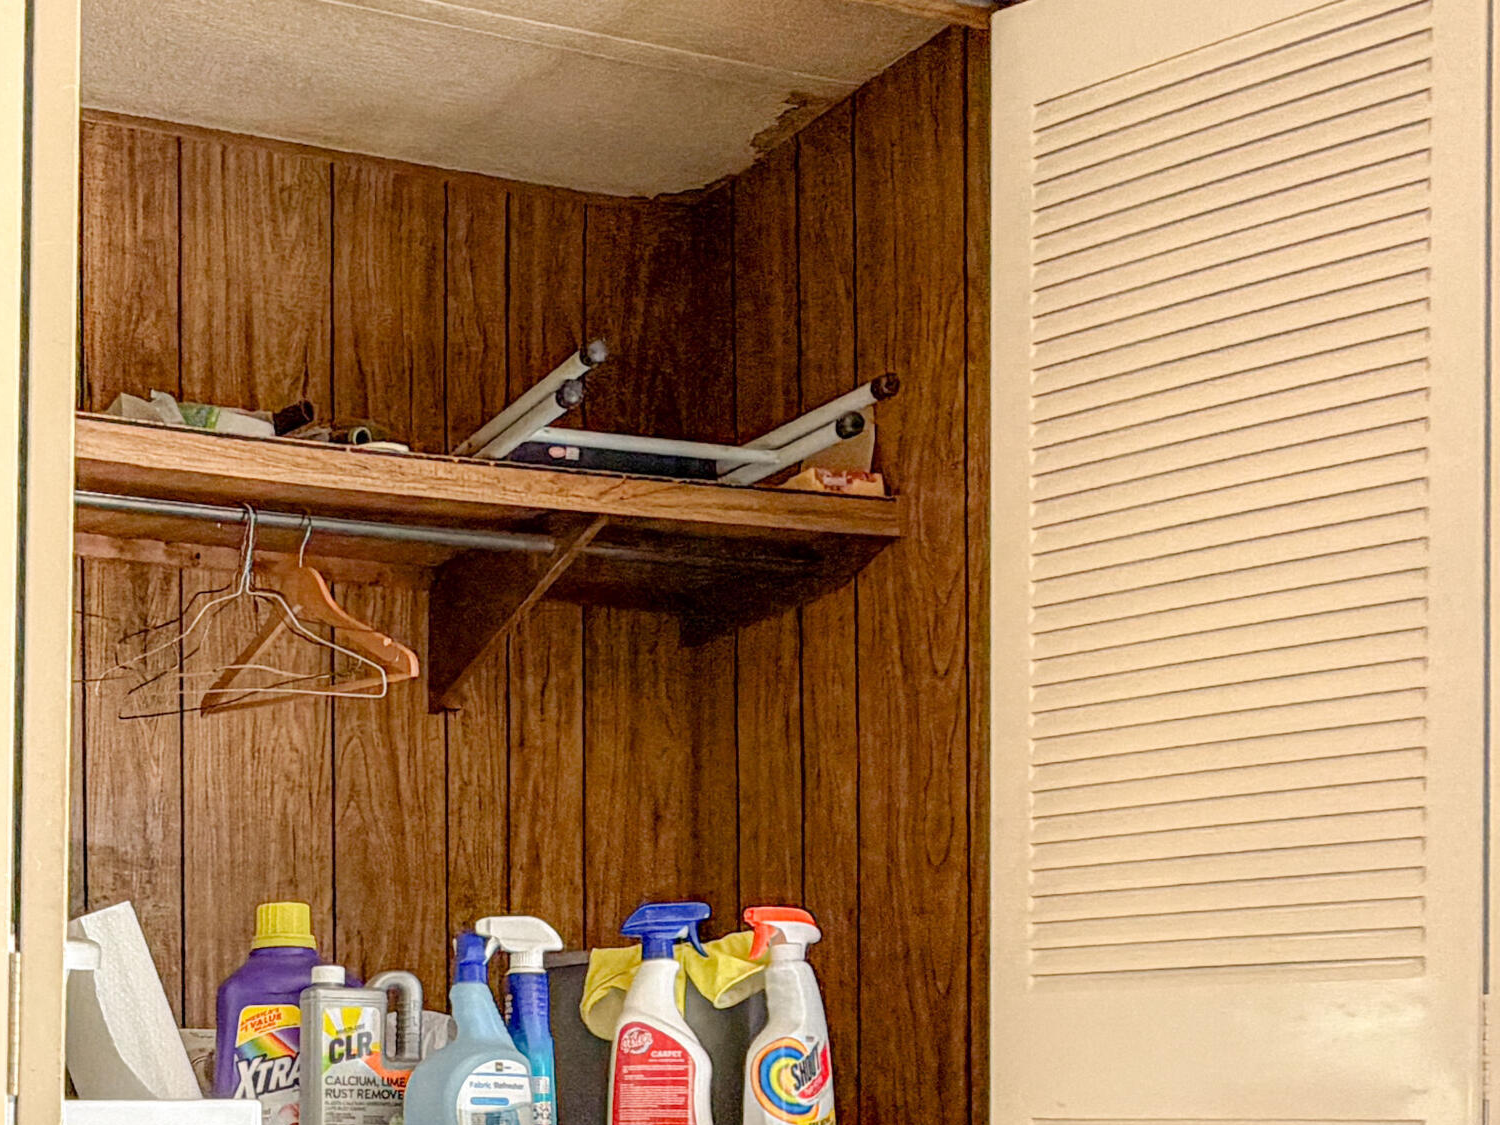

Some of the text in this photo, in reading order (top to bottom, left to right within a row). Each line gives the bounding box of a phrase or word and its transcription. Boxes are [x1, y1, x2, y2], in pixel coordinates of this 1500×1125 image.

[250, 1013, 282, 1028] VALUE
[329, 1031, 372, 1064] CLR
[650, 1050, 683, 1058] CARPET
[233, 1053, 301, 1100] XTRA
[324, 1075, 407, 1088] CALCIUM, LIME
[469, 1081, 492, 1089] Fabric
[494, 1081, 525, 1090] Refresher
[324, 1088, 354, 1099] RUST
